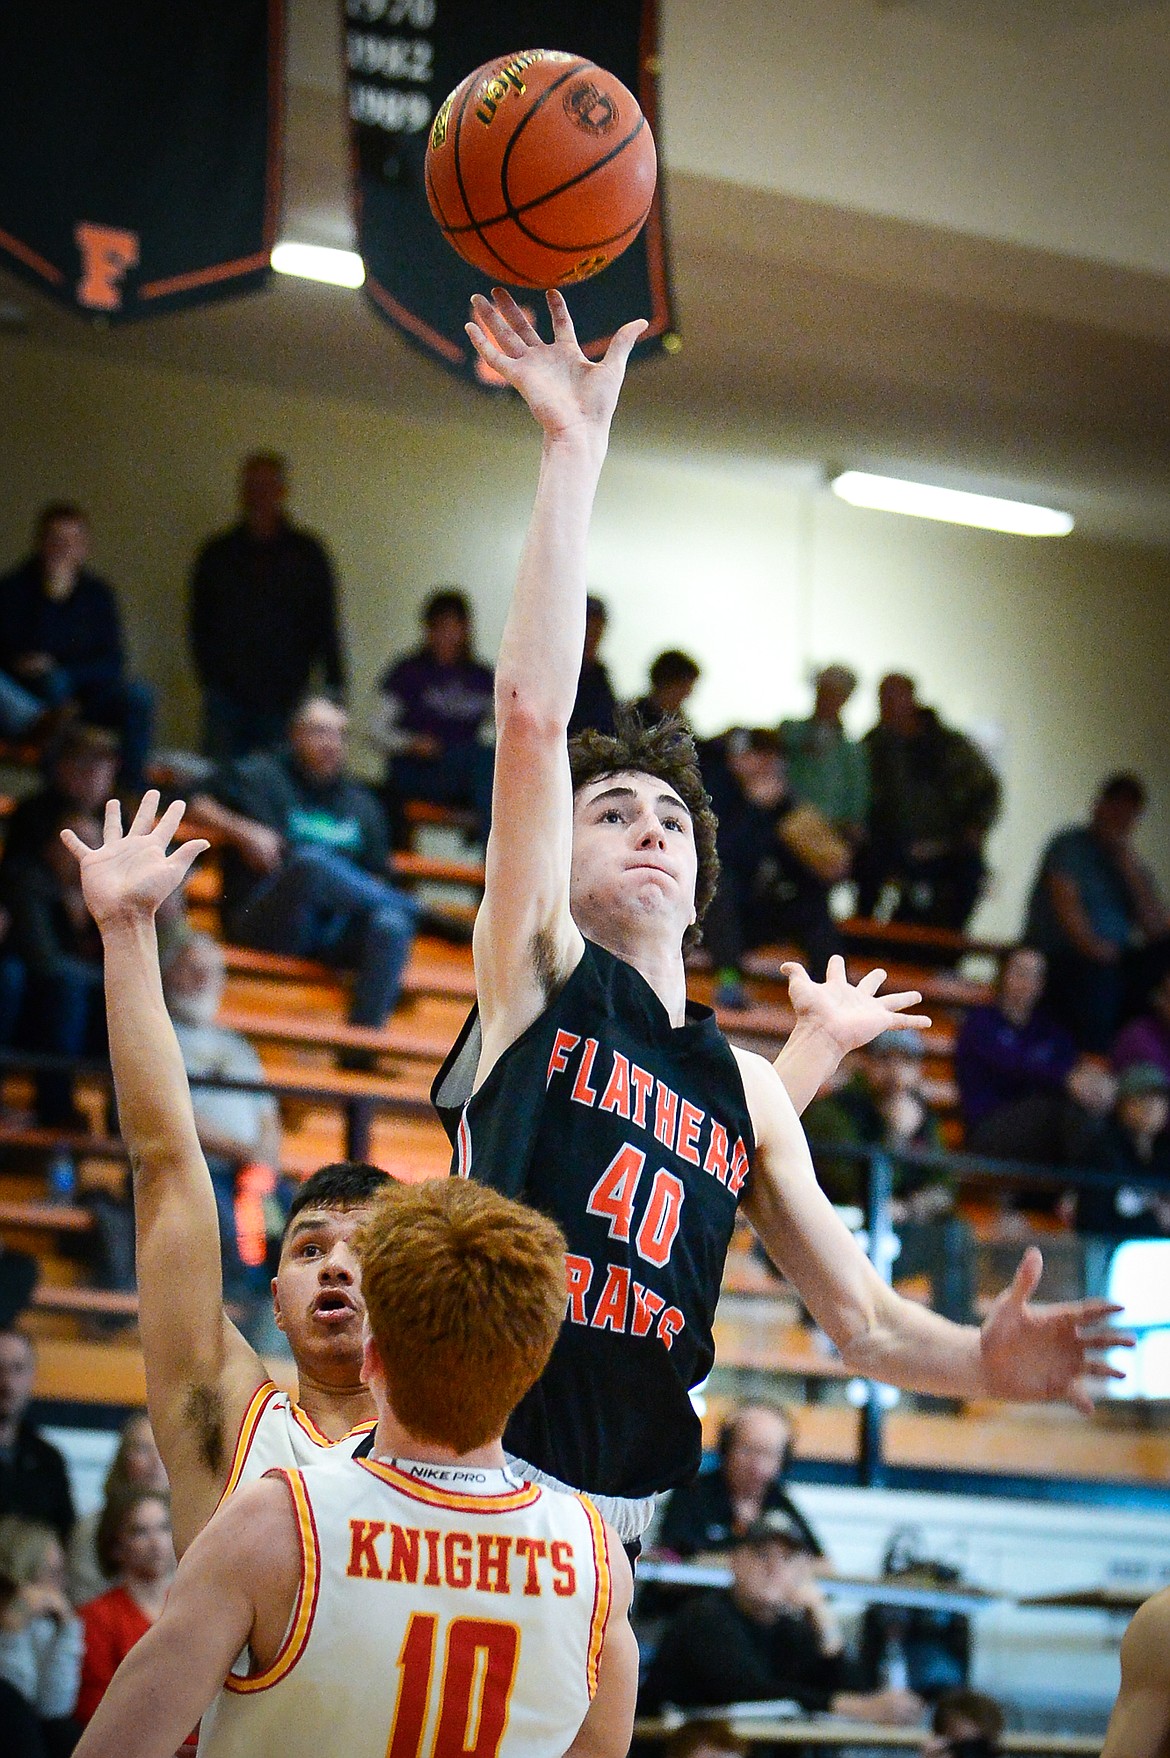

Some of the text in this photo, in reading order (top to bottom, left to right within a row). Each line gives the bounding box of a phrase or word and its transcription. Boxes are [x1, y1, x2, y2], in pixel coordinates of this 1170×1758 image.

[74, 222, 139, 309] F
[586, 1142, 685, 1269] 40
[410, 1466, 486, 1483] NIKE PRO
[346, 1518, 577, 1597] KNIGHTS
[386, 1611, 522, 1758] 10
